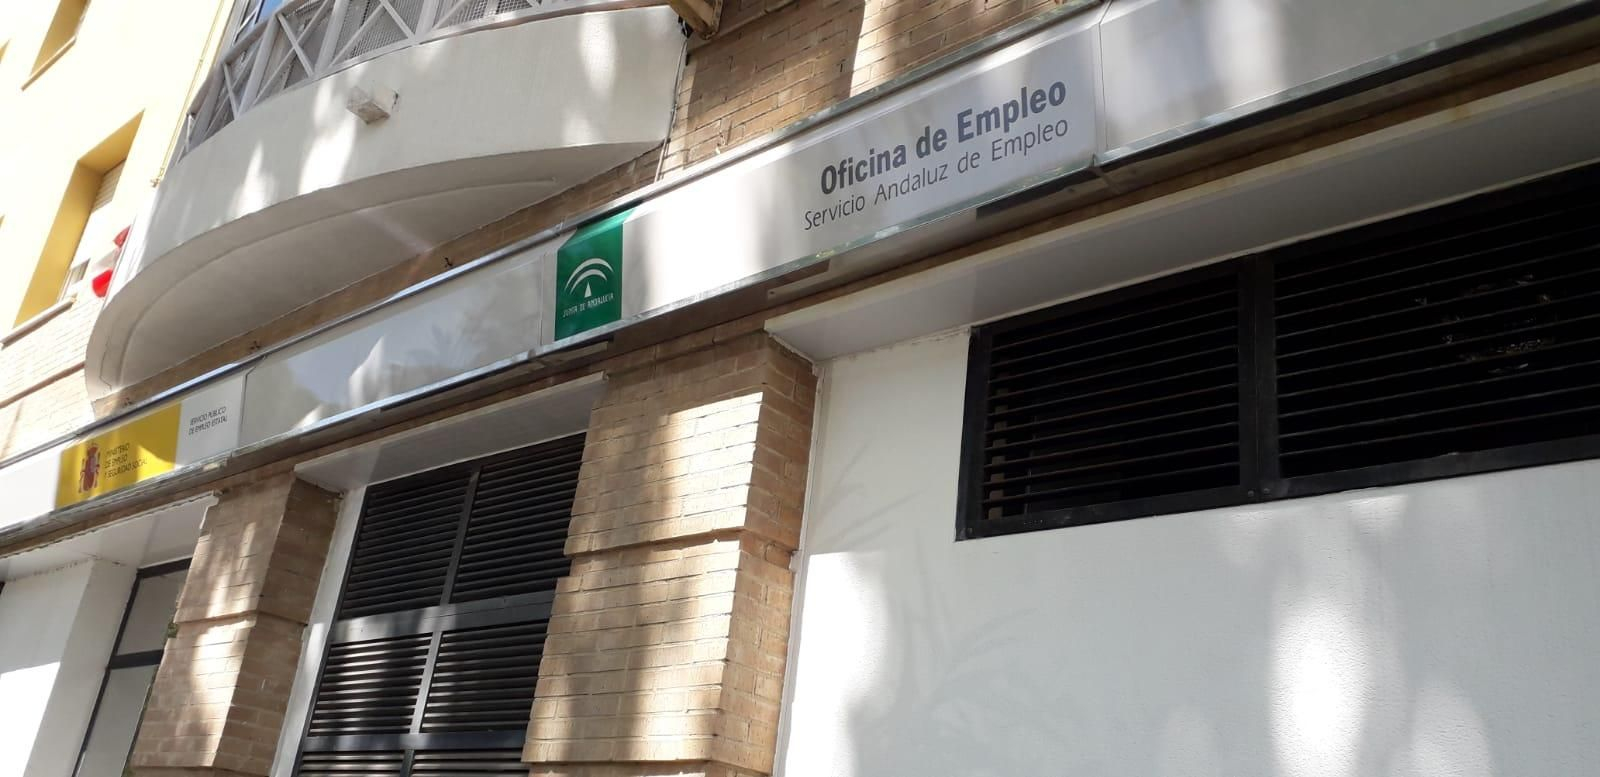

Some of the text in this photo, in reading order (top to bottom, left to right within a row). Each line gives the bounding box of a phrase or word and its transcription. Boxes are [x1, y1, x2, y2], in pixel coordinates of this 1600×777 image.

[804, 119, 1068, 231] Servicio Andaluz de Empleo
[821, 81, 1066, 195] Oficina de Empleo
